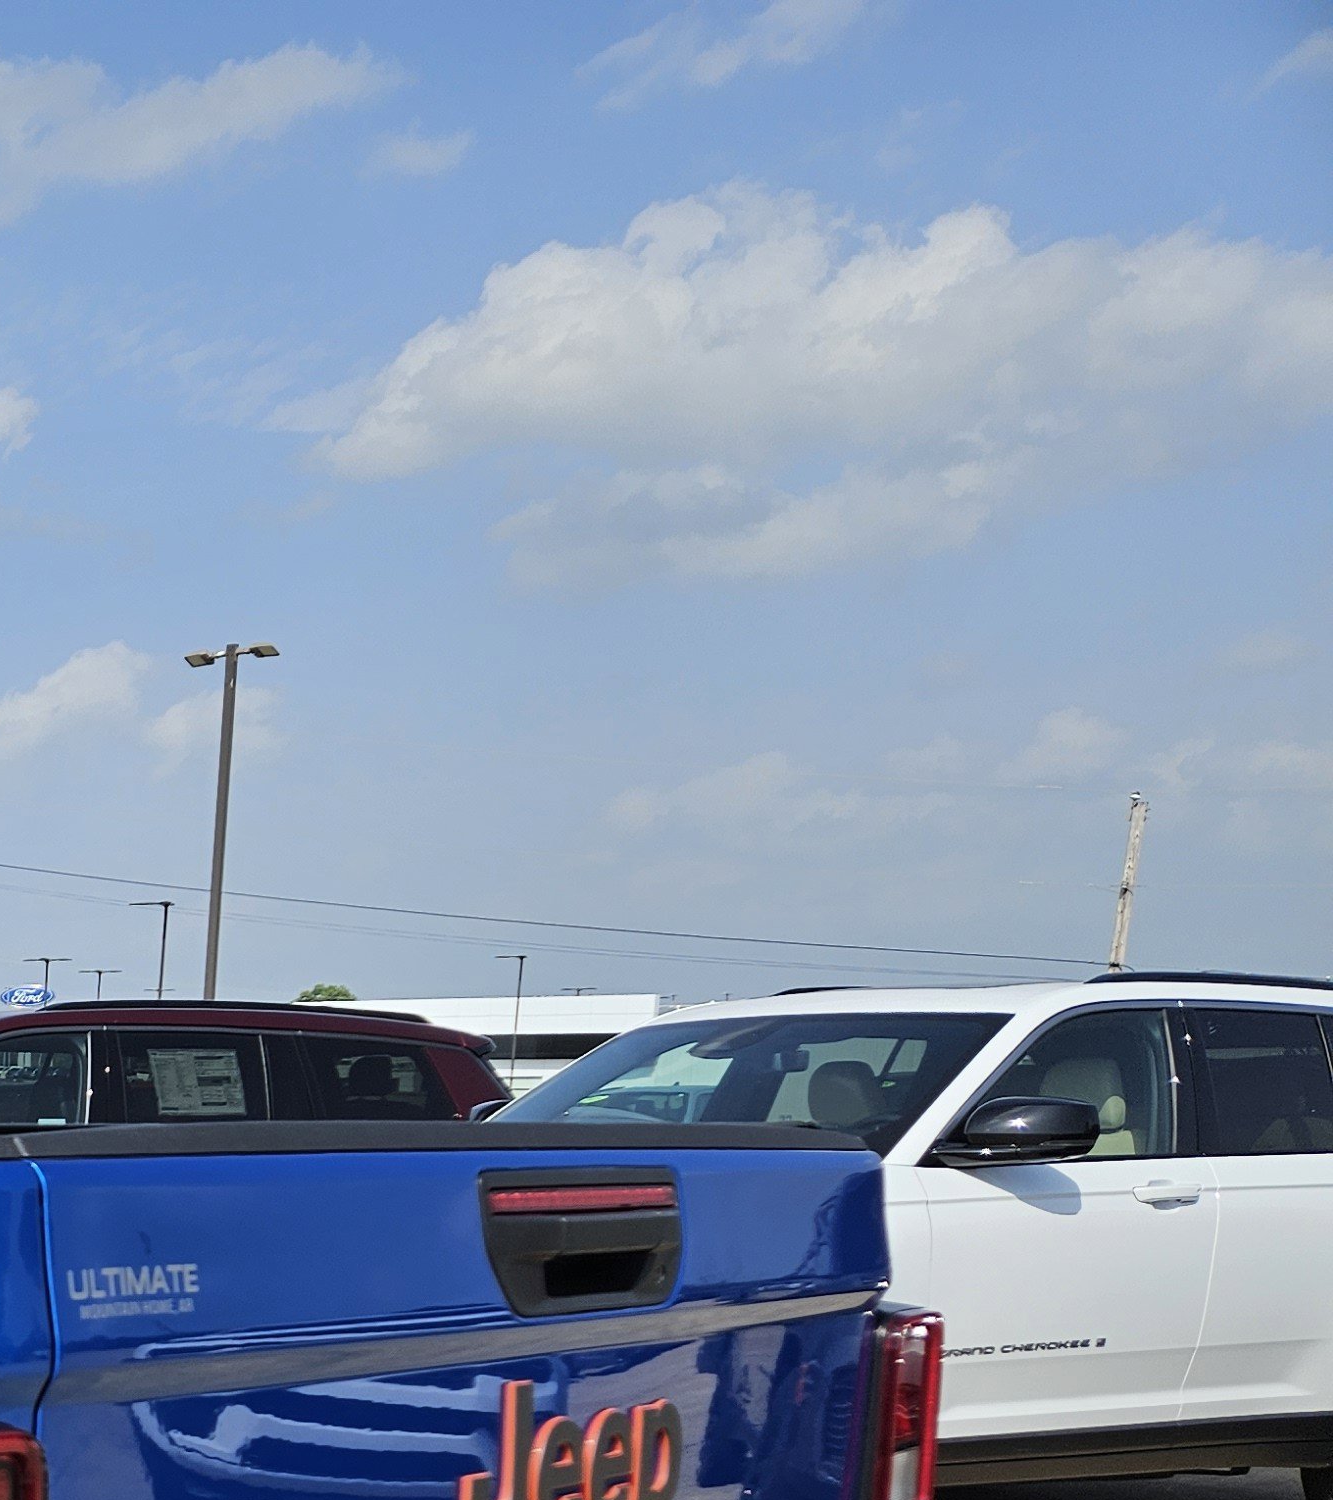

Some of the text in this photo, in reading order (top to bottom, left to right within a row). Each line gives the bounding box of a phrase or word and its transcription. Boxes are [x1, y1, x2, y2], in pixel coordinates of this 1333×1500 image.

[10, 988, 46, 1003] Ford
[66, 1263, 200, 1300] ULTIMATE
[1000, 1338, 1092, 1353] CHEROKEE
